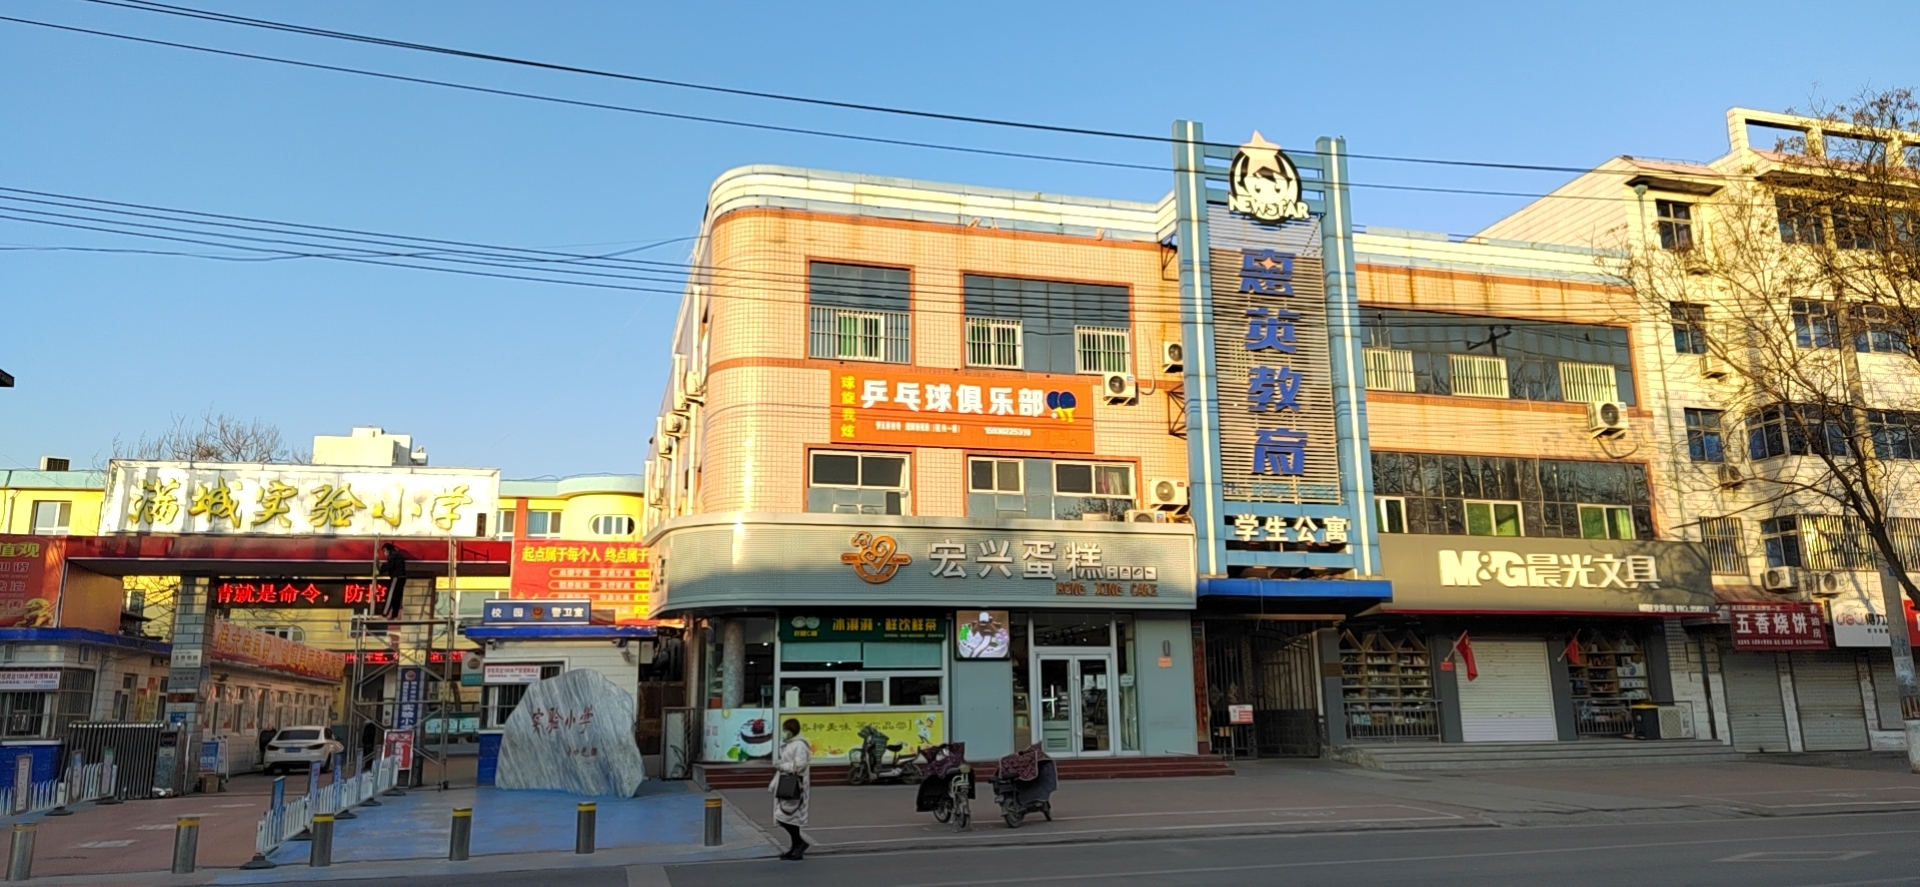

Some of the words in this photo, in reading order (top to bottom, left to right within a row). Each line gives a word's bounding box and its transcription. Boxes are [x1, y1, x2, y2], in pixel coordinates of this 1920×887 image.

[1228, 193, 1310, 219] NEWSTAR
[861, 379, 1045, 417] 乒乓球俱乐部
[128, 475, 474, 531] 满城实验小学
[1234, 513, 1348, 543] 学生公寓
[522, 546, 601, 563] 起点属于每个人
[930, 538, 1104, 580] 宏兴蛋糕
[1056, 582, 1086, 596] HONG
[1095, 583, 1122, 596] XING
[1130, 583, 1158, 597] CAKE
[491, 607, 524, 618] 校园
[551, 607, 585, 618] 警卫室
[1736, 612, 1807, 635] 五香烧饼
[1865, 613, 1888, 626] 得力
[531, 705, 594, 735] 实验小学
